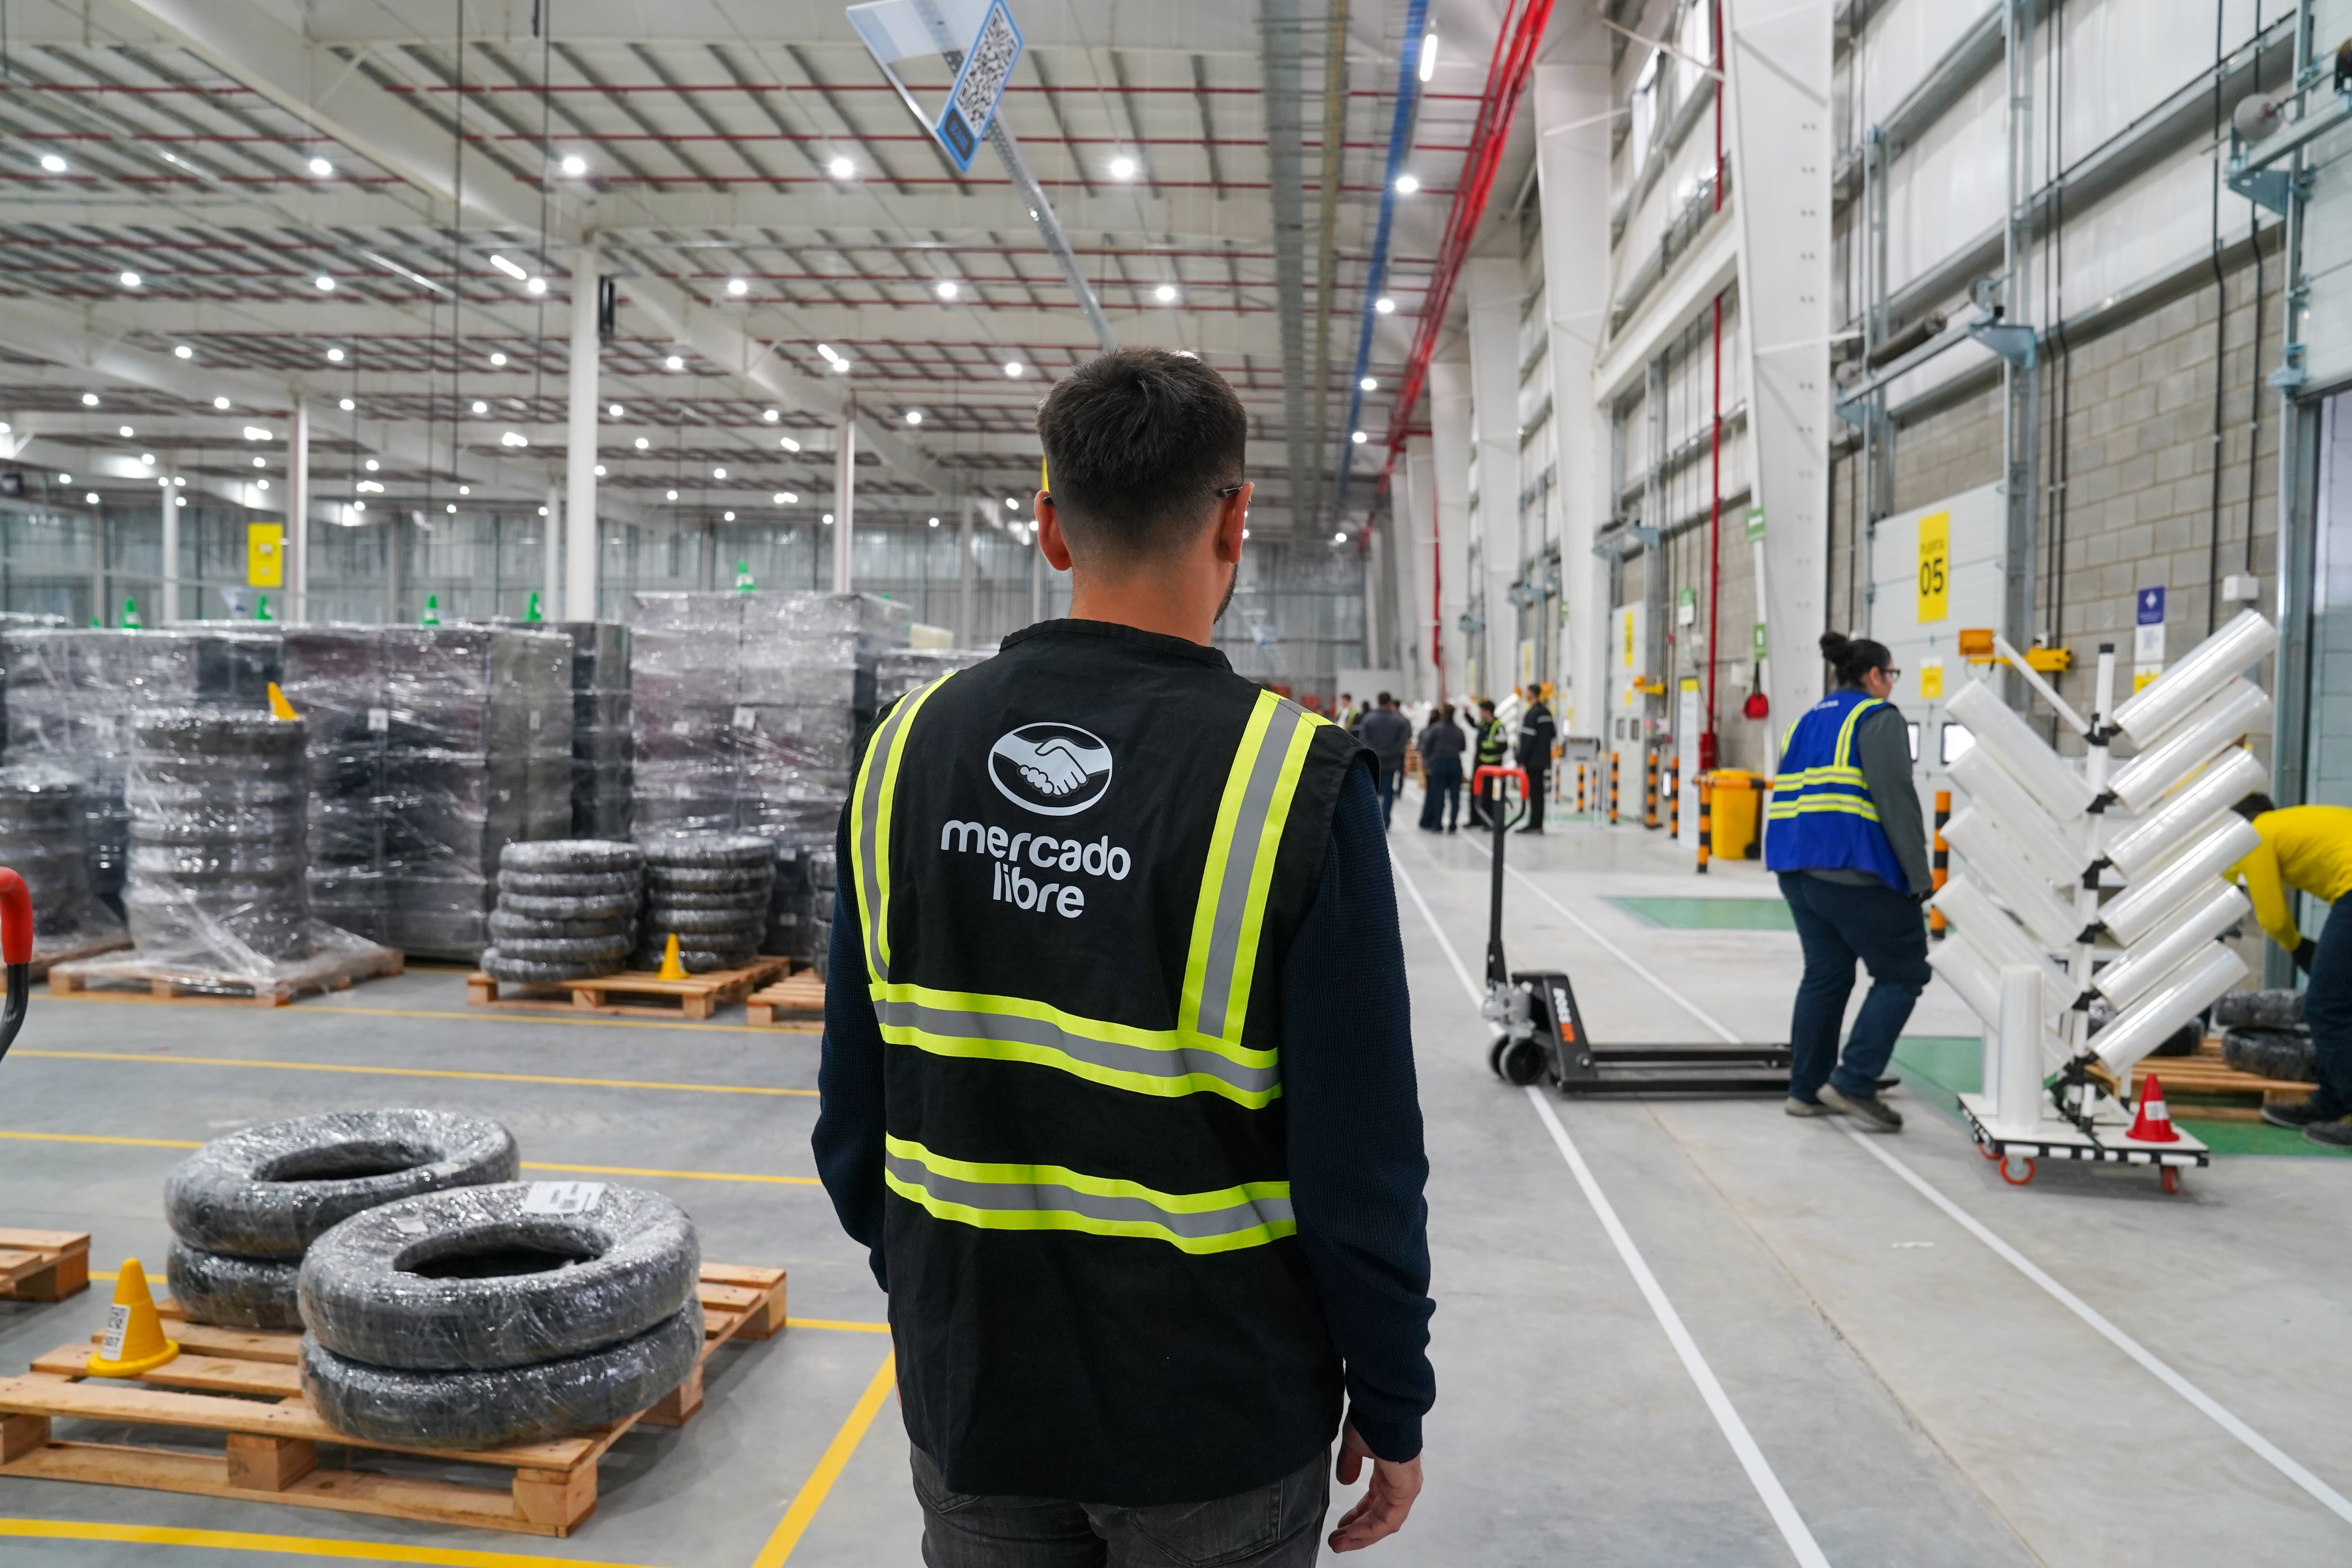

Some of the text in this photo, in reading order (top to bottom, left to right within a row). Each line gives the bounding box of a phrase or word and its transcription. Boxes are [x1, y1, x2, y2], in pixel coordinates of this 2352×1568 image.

[1920, 558, 1943, 596] 05
[941, 820, 1131, 881] mercado
[993, 861, 1084, 918] libre
